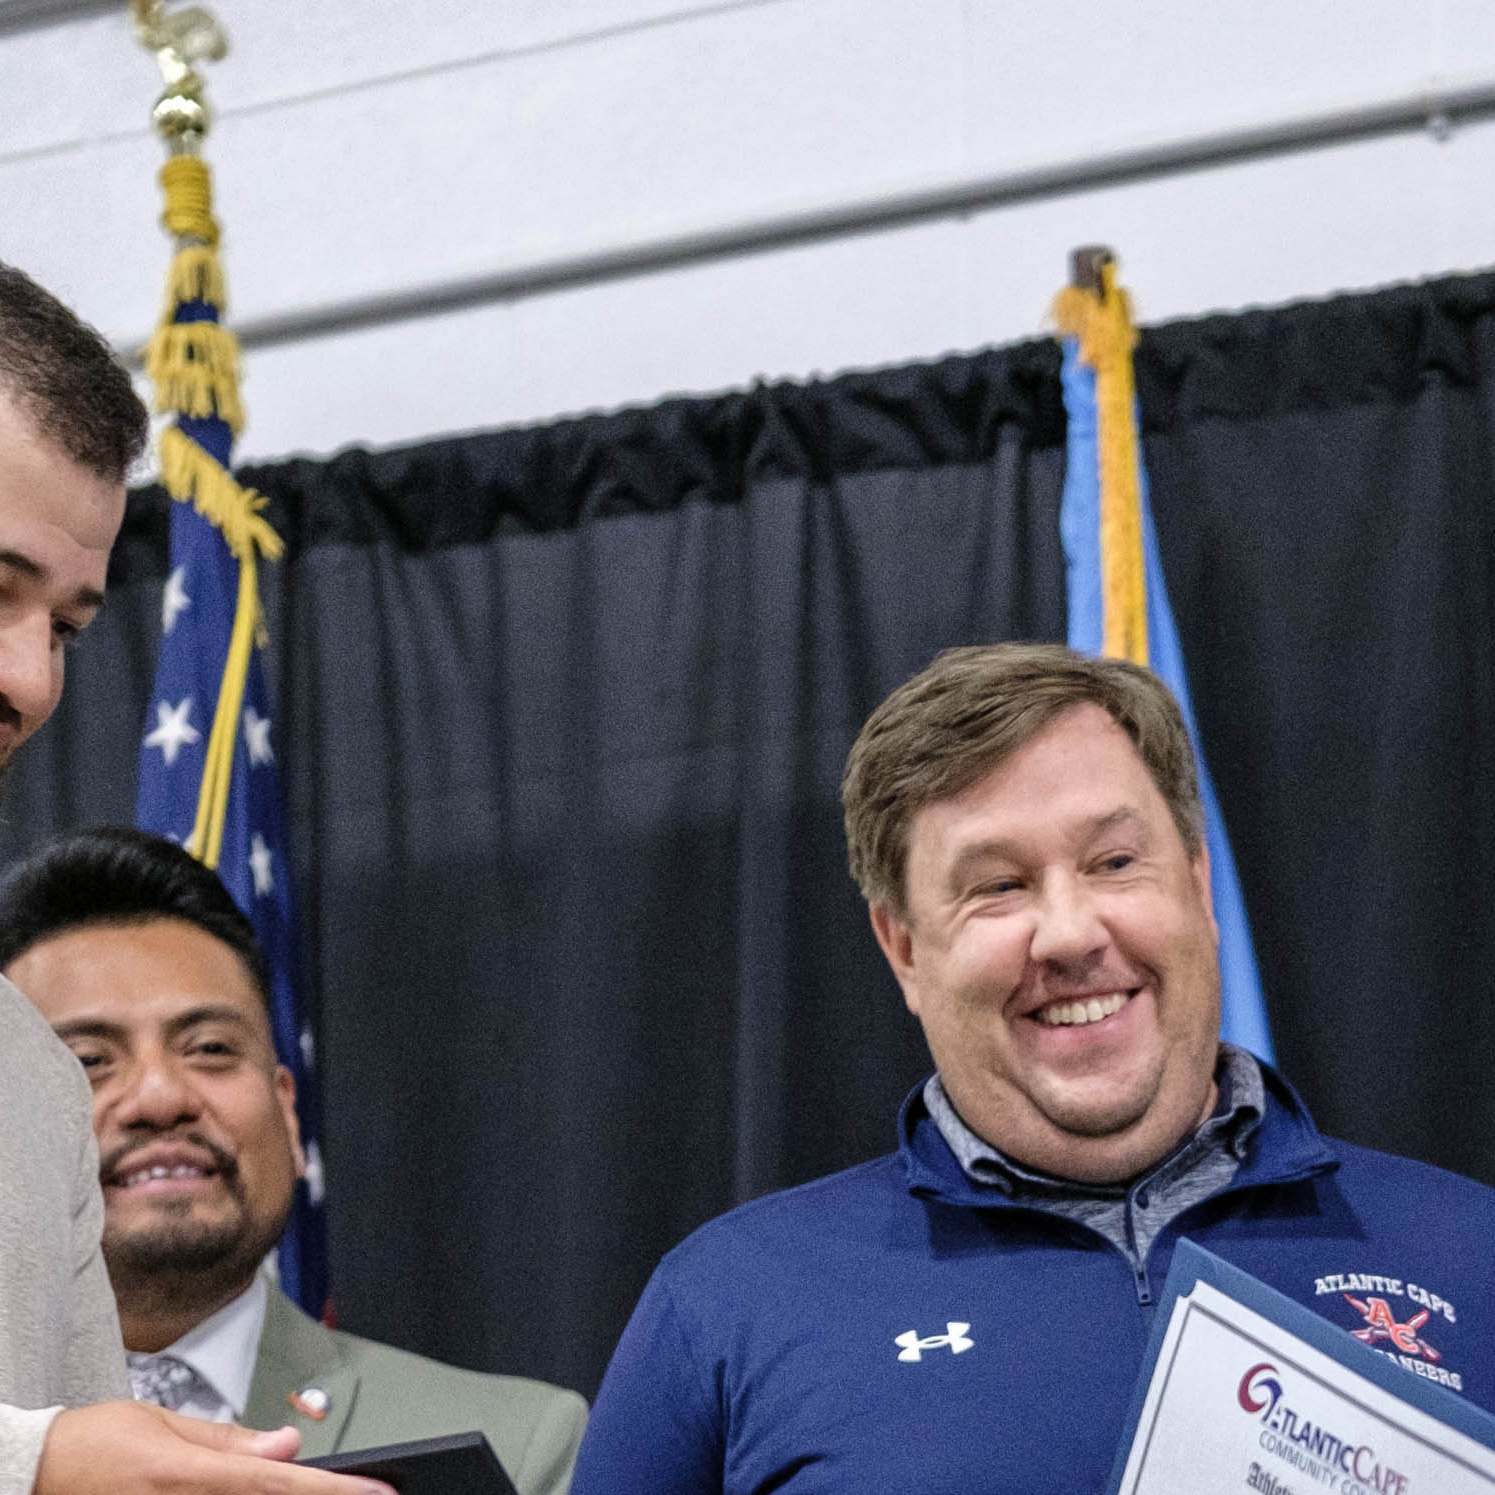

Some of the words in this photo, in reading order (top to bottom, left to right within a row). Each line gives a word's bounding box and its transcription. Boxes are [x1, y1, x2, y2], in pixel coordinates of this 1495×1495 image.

[1314, 1273, 1404, 1295] ATLANTIC
[1407, 1283, 1456, 1323] CAPE
[1259, 1430, 1339, 1488] COMMUNITY
